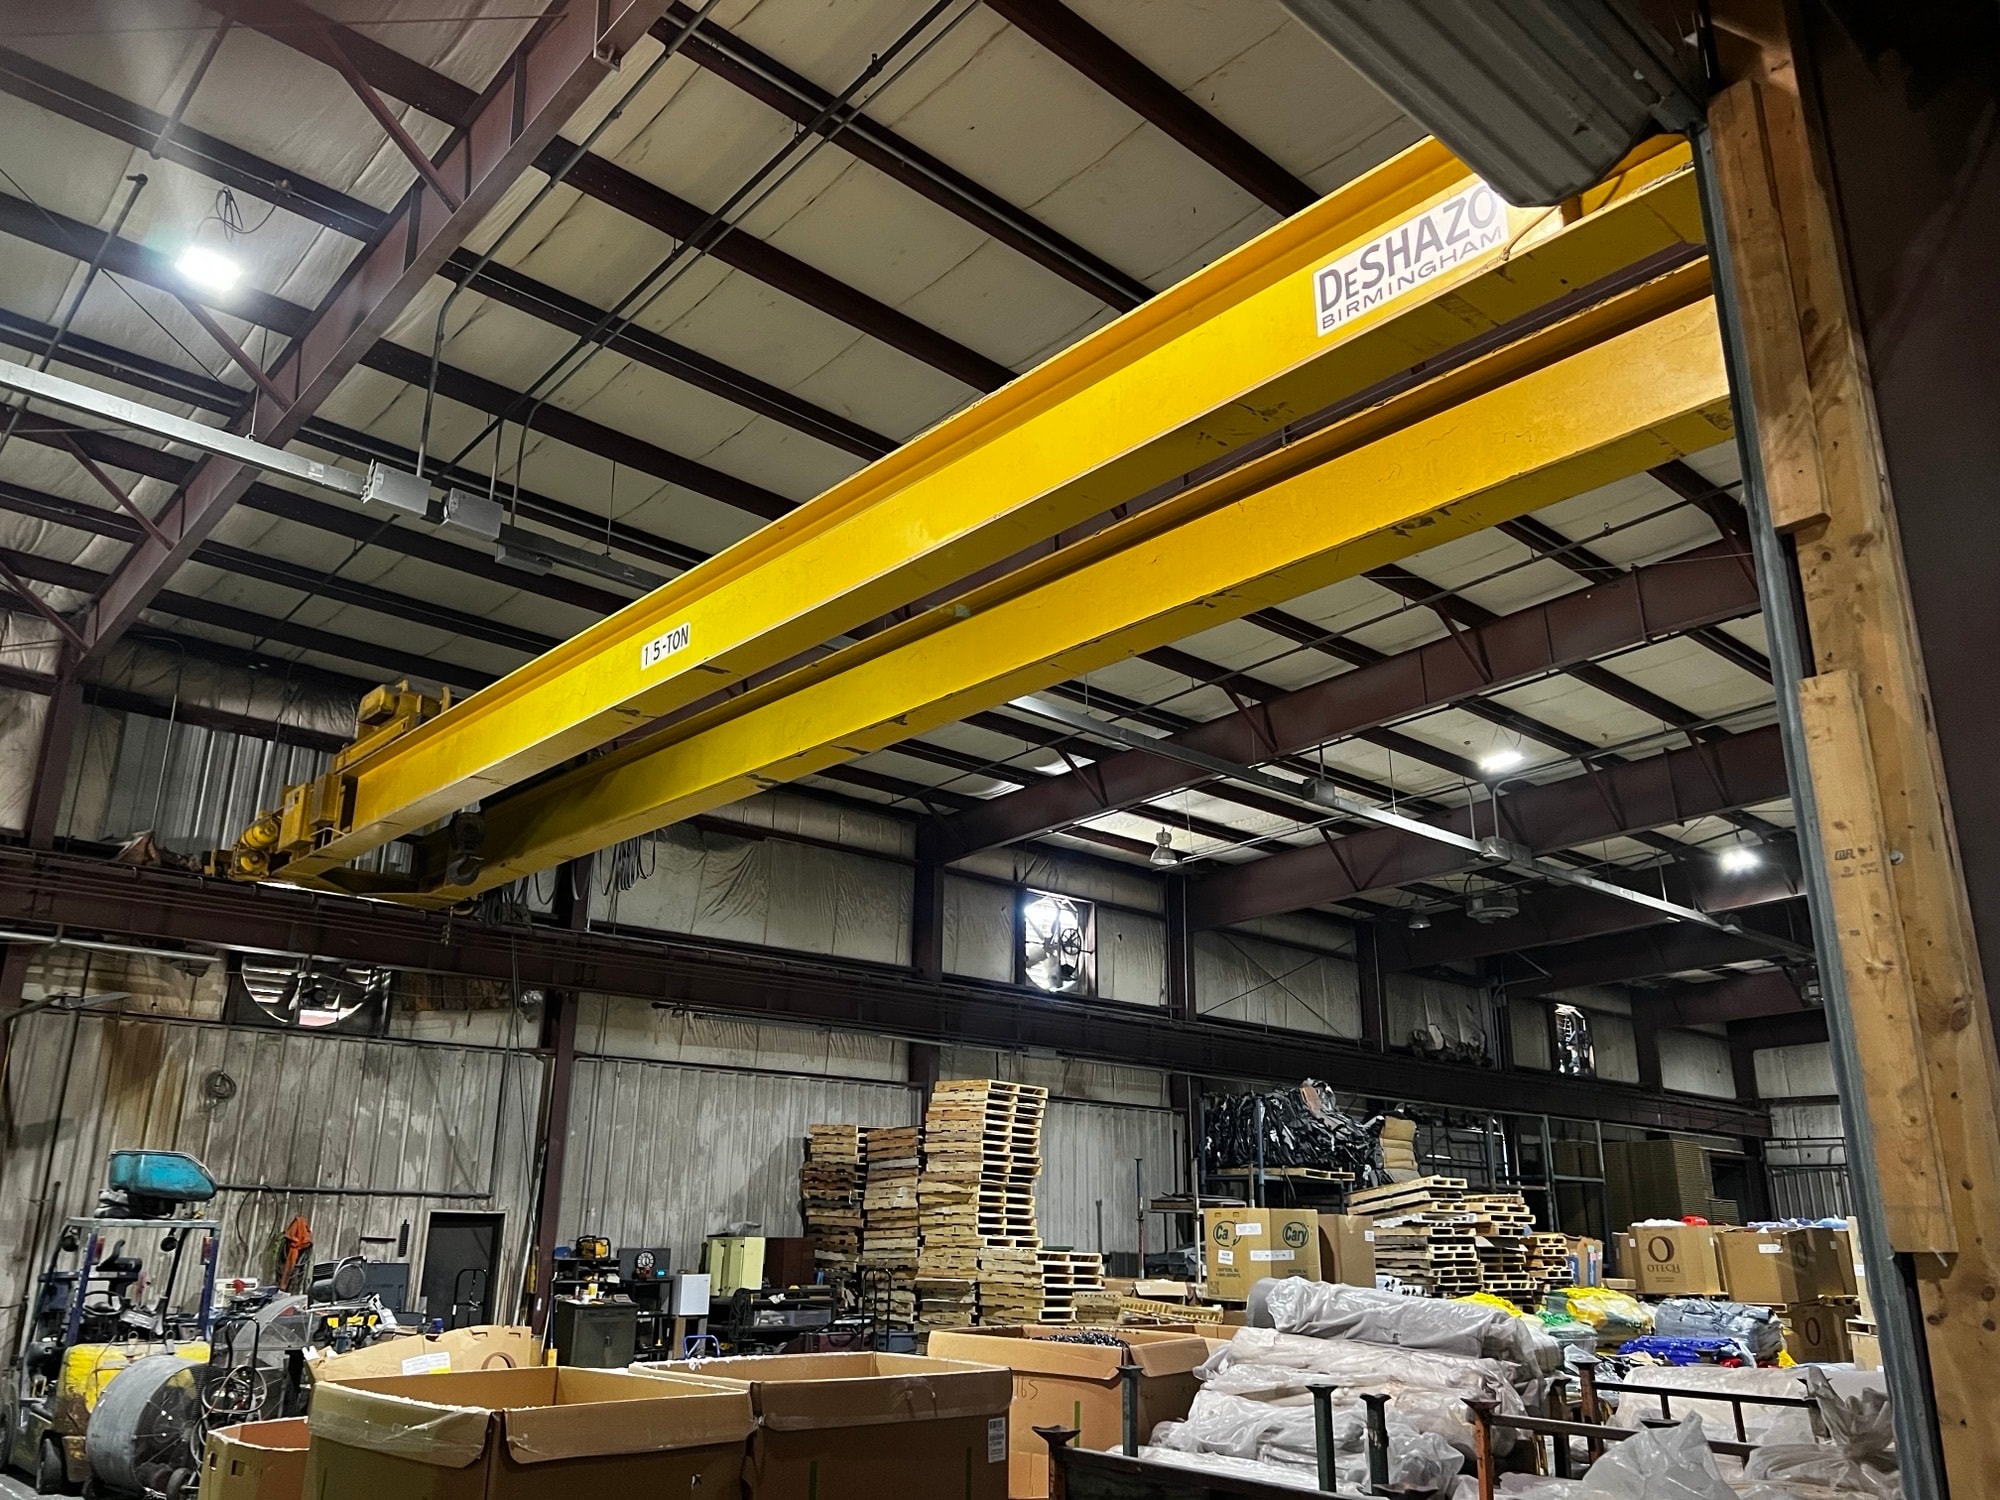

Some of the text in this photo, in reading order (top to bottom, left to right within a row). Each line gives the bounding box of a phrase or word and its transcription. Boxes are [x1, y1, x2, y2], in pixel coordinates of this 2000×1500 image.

[1319, 184, 1498, 313] DeSHAZO
[1322, 228, 1502, 330] BIRMINGHAM
[1285, 1226, 1308, 1245] Cary
